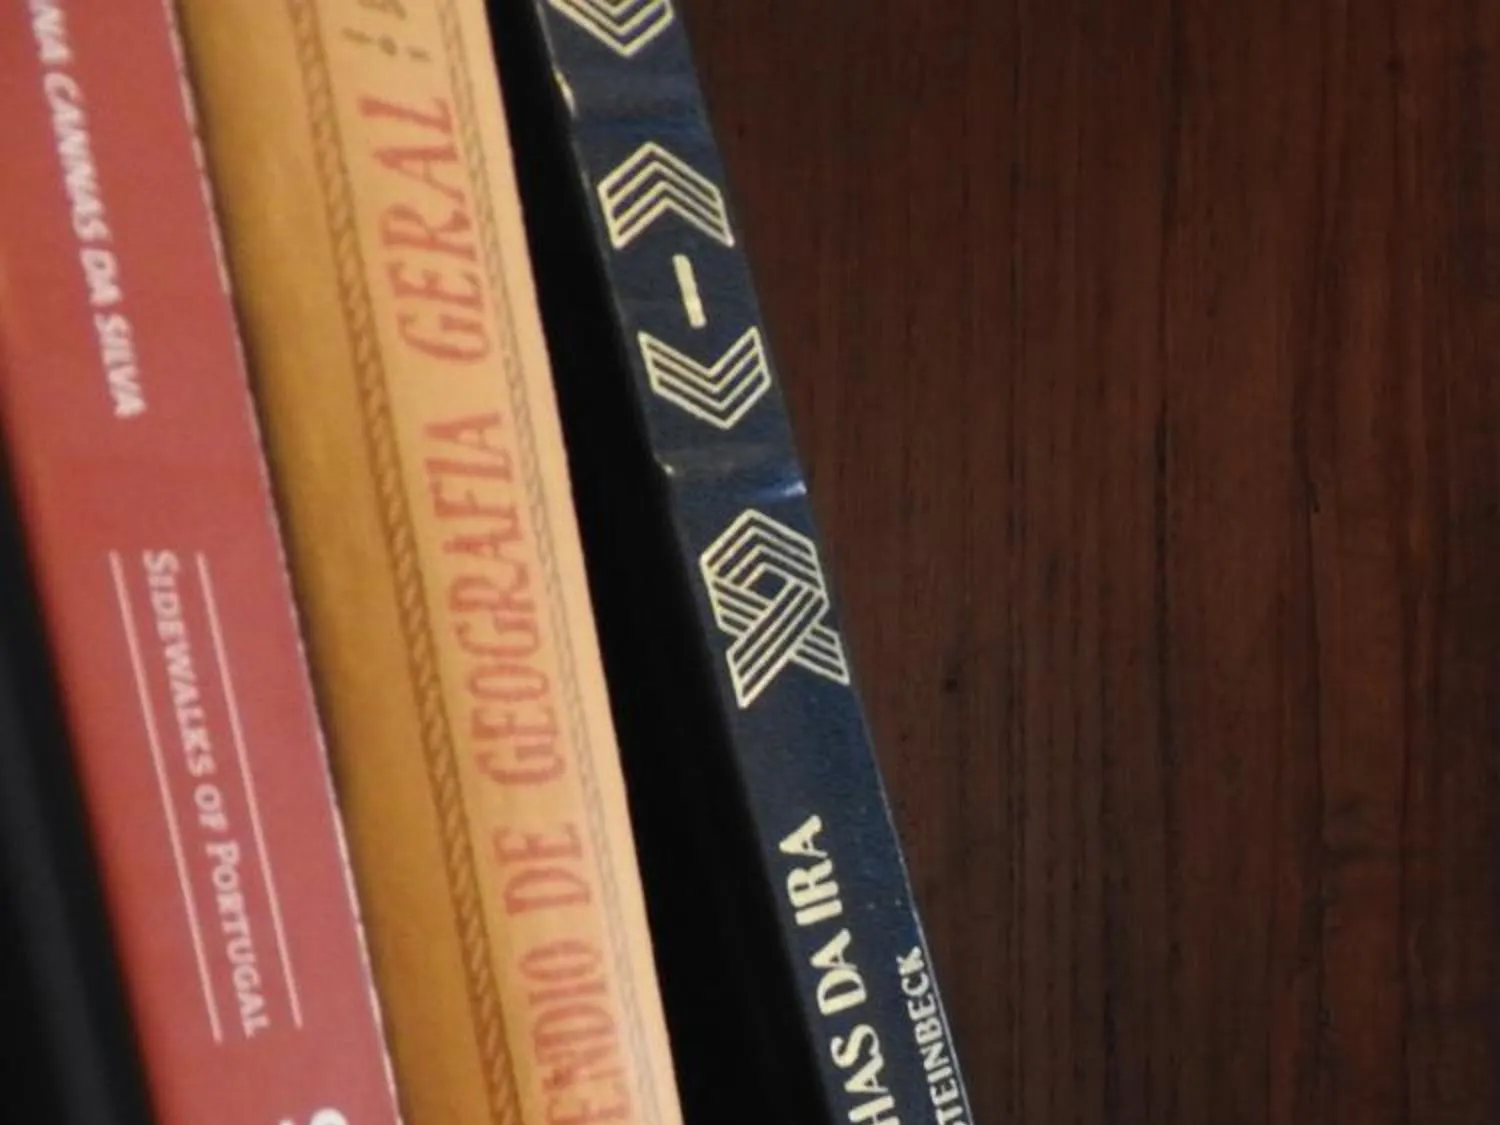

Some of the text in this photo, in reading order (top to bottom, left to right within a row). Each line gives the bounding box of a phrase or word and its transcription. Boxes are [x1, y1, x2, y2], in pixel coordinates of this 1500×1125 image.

[80, 247, 122, 305] DA
[357, 95, 493, 365] GERAL
[94, 312, 147, 419] SILVA
[421, 411, 566, 787] GEOGRAFIA
[492, 820, 594, 918] DE
[778, 813, 844, 926] IRA
[809, 928, 868, 1017] DA
